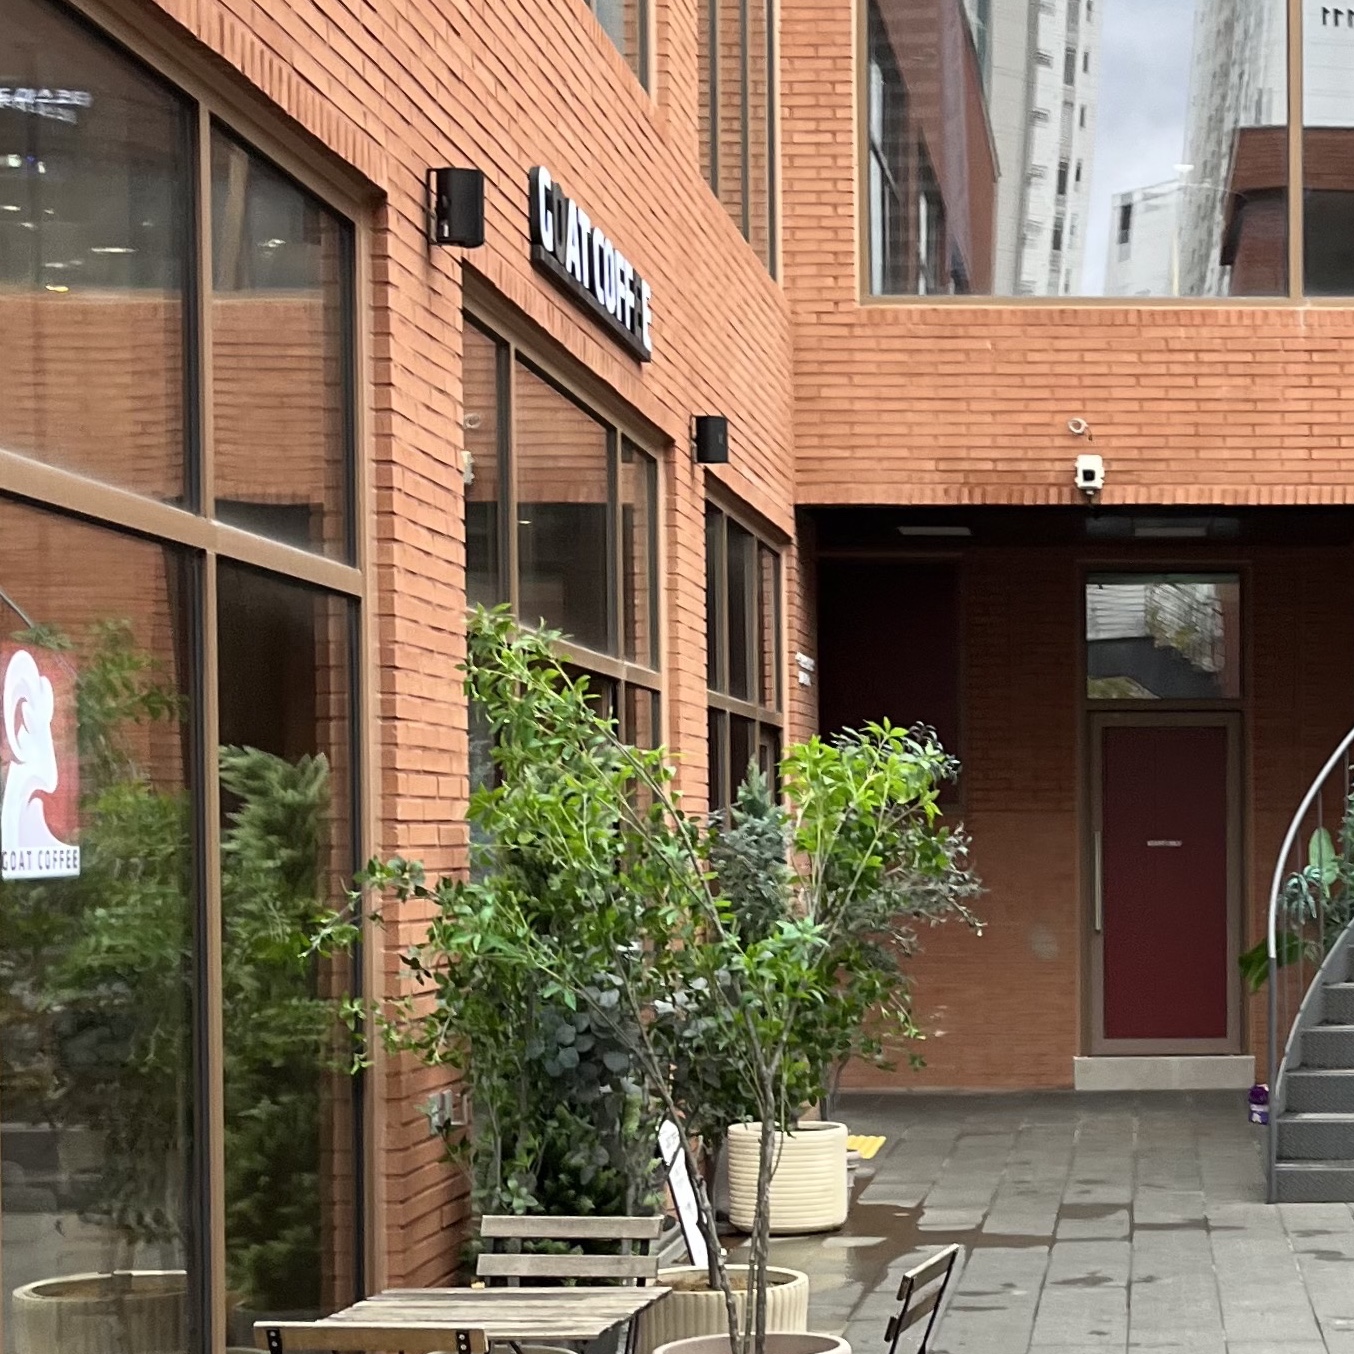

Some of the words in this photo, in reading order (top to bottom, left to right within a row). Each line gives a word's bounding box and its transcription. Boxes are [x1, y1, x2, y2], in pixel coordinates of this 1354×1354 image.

[537, 165, 591, 290] GOAT
[592, 226, 653, 352] COFFEE
[2, 850, 32, 871] GOAT
[38, 849, 79, 870] COFFEE
